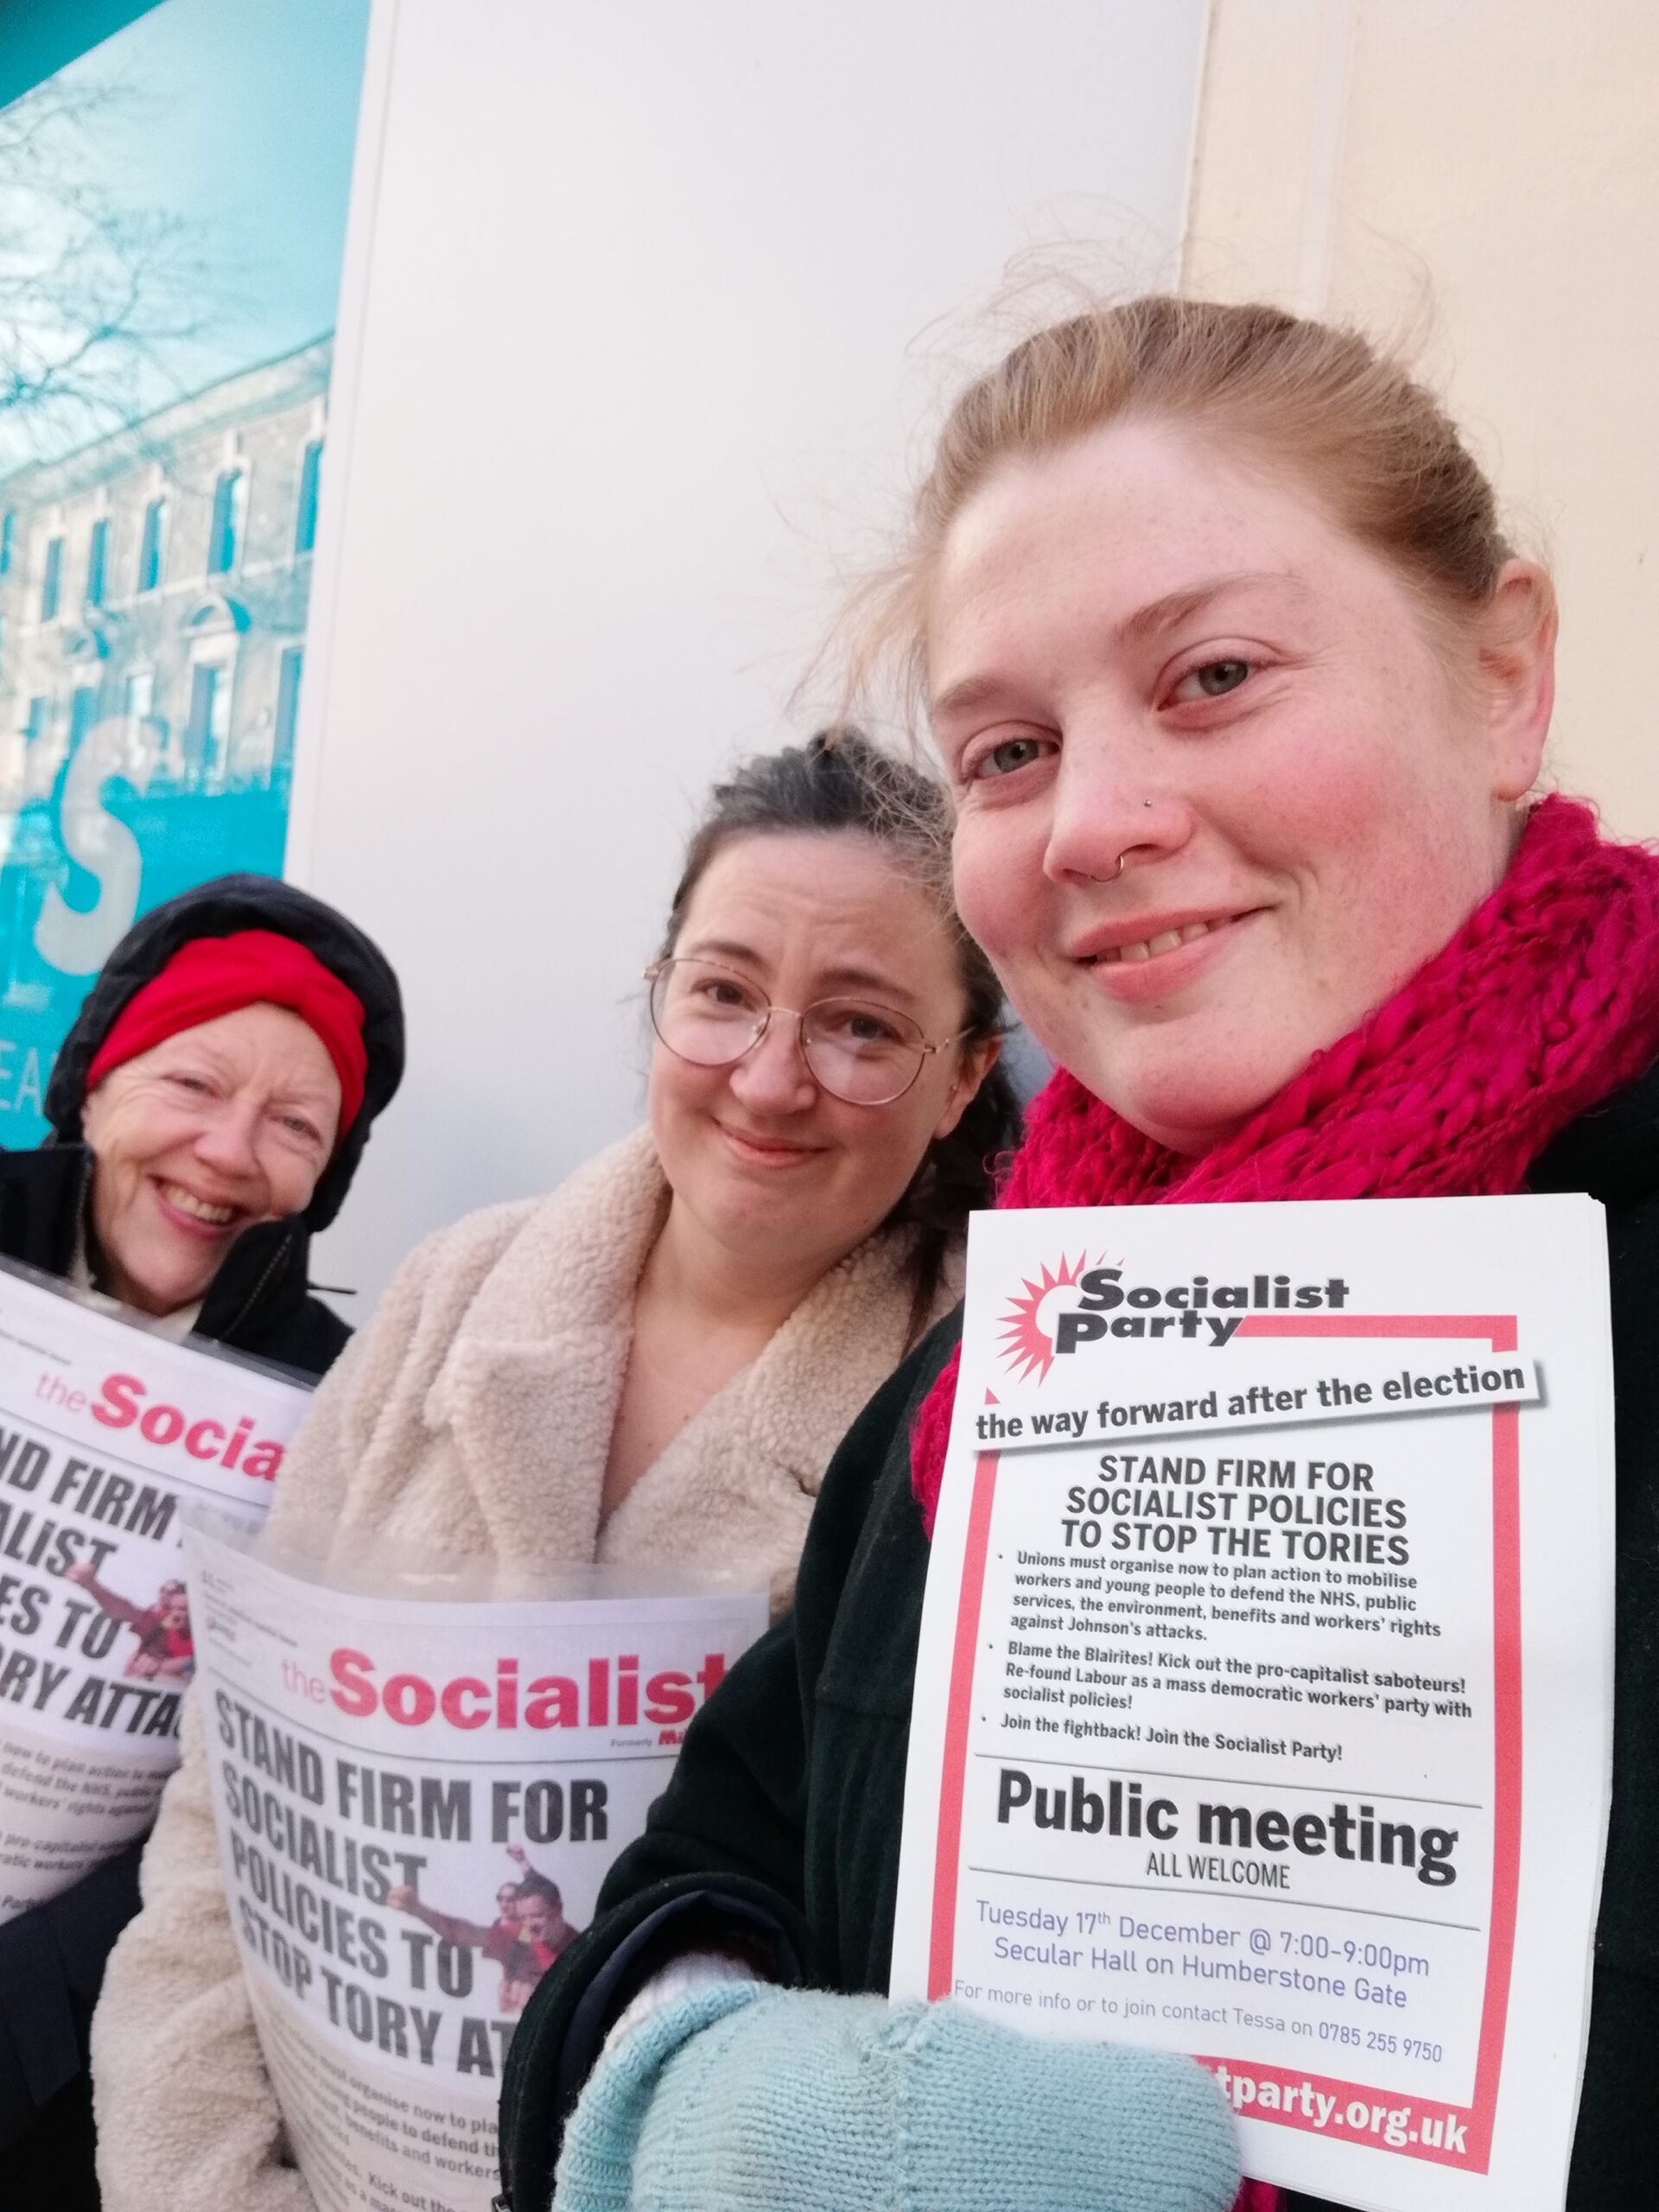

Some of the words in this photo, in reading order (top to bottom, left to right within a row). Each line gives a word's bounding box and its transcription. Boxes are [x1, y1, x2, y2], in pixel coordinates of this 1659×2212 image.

[1077, 1268, 1350, 1311] Socialist
[35, 1371, 87, 1413] the
[91, 1373, 286, 1482] Socia
[976, 1413, 1023, 1440] the
[1031, 1410, 1089, 1438] way
[1096, 1391, 1217, 1428] forward
[1228, 1386, 1307, 1416] after
[1316, 1378, 1372, 1407] the
[1382, 1365, 1525, 1401] election
[50, 1457, 180, 1541] FIRM
[1097, 1455, 1206, 1485] STAND
[1217, 1459, 1296, 1489] FIRM
[1307, 1461, 1374, 1492] FOR
[1065, 1485, 1238, 1521] SOCIALIST
[1248, 1493, 1407, 1529] POLICIES
[1017, 1550, 1065, 1567] Unions
[1069, 1554, 1106, 1569] must
[1109, 1558, 1173, 1574] organise
[1178, 1562, 1209, 1576] now
[1211, 1561, 1229, 1577] to
[1231, 1563, 1267, 1581] plan
[1269, 1566, 1321, 1582] action
[1324, 1567, 1342, 1584] to
[1345, 1570, 1417, 1589] mobilise
[1061, 1519, 1102, 1548] TO
[1111, 1522, 1197, 1554] STOP
[1207, 1526, 1271, 1558] THE
[1281, 1529, 1409, 1566] TORIES
[1012, 1593, 1075, 1611] services,
[1079, 1596, 1103, 1611] the
[1107, 1599, 1206, 1621] environment,
[1211, 1604, 1276, 1624] benefits
[1280, 1611, 1310, 1626] and
[1313, 1613, 1385, 1631] workers'
[1389, 1617, 1441, 1638] rights
[1014, 1572, 1071, 1588] workers
[1075, 1575, 1102, 1590] and
[1104, 1580, 1151, 1597] young
[1154, 1581, 1205, 1599] people
[1208, 1582, 1226, 1598] to
[1229, 1583, 1285, 1602] defend
[1287, 1587, 1315, 1604] the
[1319, 1589, 1360, 1609] NHS,
[1363, 1593, 1417, 1611] public
[55, 1600, 123, 1659] TO
[1009, 1613, 1064, 1630] against
[1067, 1616, 1141, 1636] Johnson's
[1144, 1623, 1207, 1641] attacks.
[282, 1659, 325, 1704] the
[329, 1648, 728, 1729] Socialist
[1006, 1662, 1071, 1681] Re-found
[1075, 1668, 1128, 1686] Labour
[1130, 1675, 1148, 1688] as
[1151, 1677, 1161, 1689] a
[1165, 1678, 1206, 1693] mass
[1210, 1678, 1303, 1702] democratic
[1305, 1688, 1379, 1708] workers'
[1382, 1696, 1430, 1718] party
[1432, 1699, 1471, 1718] with
[1007, 1640, 1052, 1658] Blame
[1055, 1644, 1080, 1660] the
[1084, 1646, 1154, 1666] Blairites!
[1157, 1651, 1191, 1669] Kick
[1194, 1656, 1222, 1672] out
[1224, 1657, 1252, 1675] the
[1255, 1662, 1370, 1685] pro-capitalist
[1372, 1670, 1465, 1694] saboteurs!
[1002, 1685, 1065, 1703] socialist
[1068, 1689, 1133, 1709] policies!
[1001, 1712, 1031, 1730] Join
[1033, 1715, 1059, 1733] the
[1062, 1718, 1141, 1741] fightback!
[1144, 1726, 1179, 1745] Join
[1182, 1729, 1210, 1748] the
[1213, 1732, 1287, 1756] Socialist
[1290, 1739, 1342, 1764] Party!
[215, 1688, 324, 1806] STAND
[337, 1758, 472, 1843] FIRM
[493, 1778, 608, 1844] FOR
[222, 1758, 428, 1907] SOCIALIST
[998, 1769, 1179, 1840] Public
[1198, 1803, 1459, 1886] meeting
[1146, 1851, 1182, 1878] ALL
[1187, 1854, 1290, 1889] WELCOME
[231, 1827, 388, 1979] POLICIES
[401, 1929, 474, 1998] TO
[976, 1900, 1068, 1936] Tuesday
[1120, 1916, 1241, 1946] December
[1249, 1929, 1271, 1955] @
[1281, 1931, 1428, 1976] 7:00-9:00pm
[239, 1895, 313, 2001] STOP
[321, 1965, 442, 2066] TORY
[995, 1937, 1083, 1967] Secular
[1092, 1948, 1137, 1972] Hall
[1147, 1958, 1173, 1974] on
[1184, 1955, 1345, 1996] Humberstone
[1355, 1978, 1407, 2008] Gate
[955, 1980, 982, 1999] For
[988, 1989, 1032, 2005] more
[1039, 1990, 1071, 2011] info
[1077, 1999, 1096, 2011] or
[1102, 1999, 1117, 2013] to
[1123, 1998, 1155, 2019] join
[1162, 2005, 1227, 2023] contact
[1233, 2008, 1285, 2032] Tessa
[1292, 2022, 1313, 2036] on
[1319, 2022, 1360, 2046] 0785
[1367, 2031, 1396, 2053] 255
[1403, 2038, 1442, 2063] 9750
[349, 2075, 409, 2113] organise
[414, 2104, 445, 2124] now
[449, 2112, 467, 2129] to
[353, 2100, 398, 2132] people
[402, 2120, 418, 2139] to
[422, 2127, 479, 2155] defend
[402, 2145, 430, 2164] and
[368, 2170, 397, 2199] Kick
[402, 2191, 427, 2211] out
